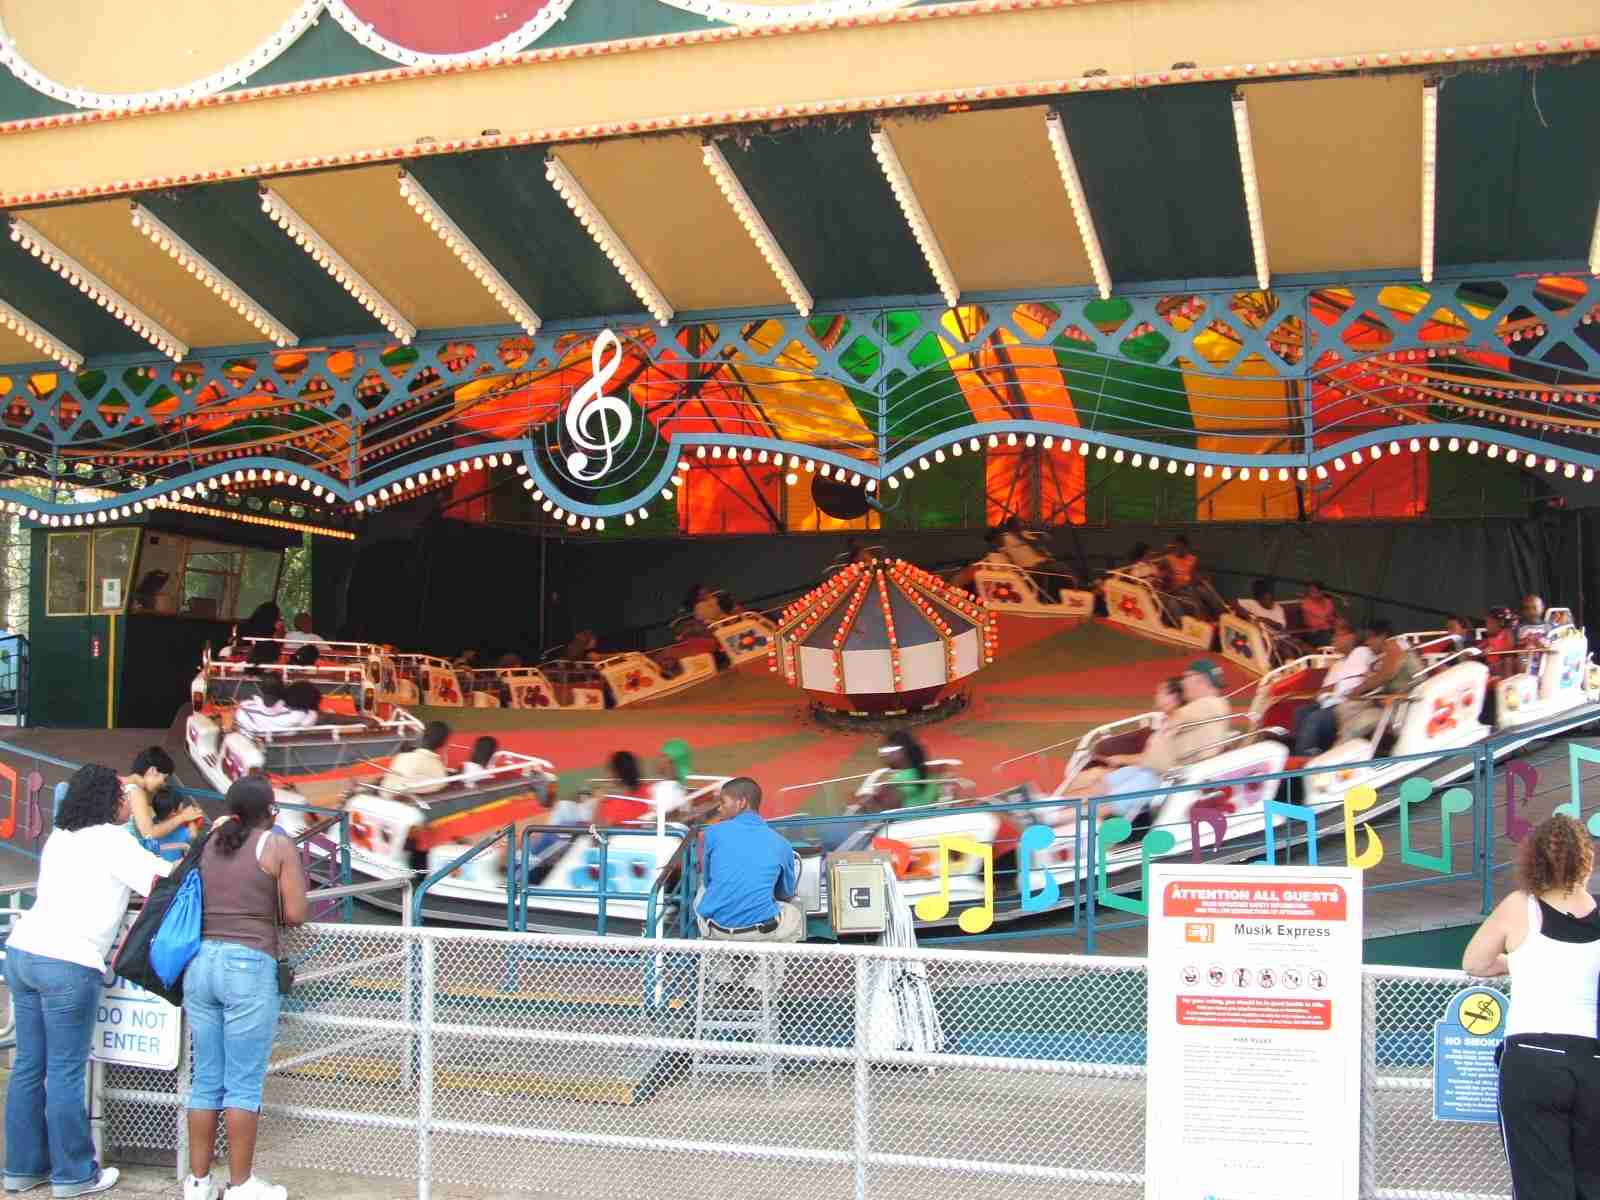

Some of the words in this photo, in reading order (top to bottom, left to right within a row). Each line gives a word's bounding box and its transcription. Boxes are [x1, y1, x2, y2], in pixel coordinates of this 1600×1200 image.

[1172, 888, 1249, 901] ATTENTION
[1254, 890, 1280, 902] ALL
[1283, 890, 1339, 903] GUESTS
[1234, 923, 1273, 936] Musik
[1277, 924, 1331, 939] Express
[96, 1006, 122, 1025] DO
[132, 1008, 168, 1029] NOT
[103, 1031, 161, 1056] ENTER
[1444, 1036, 1461, 1046] NO
